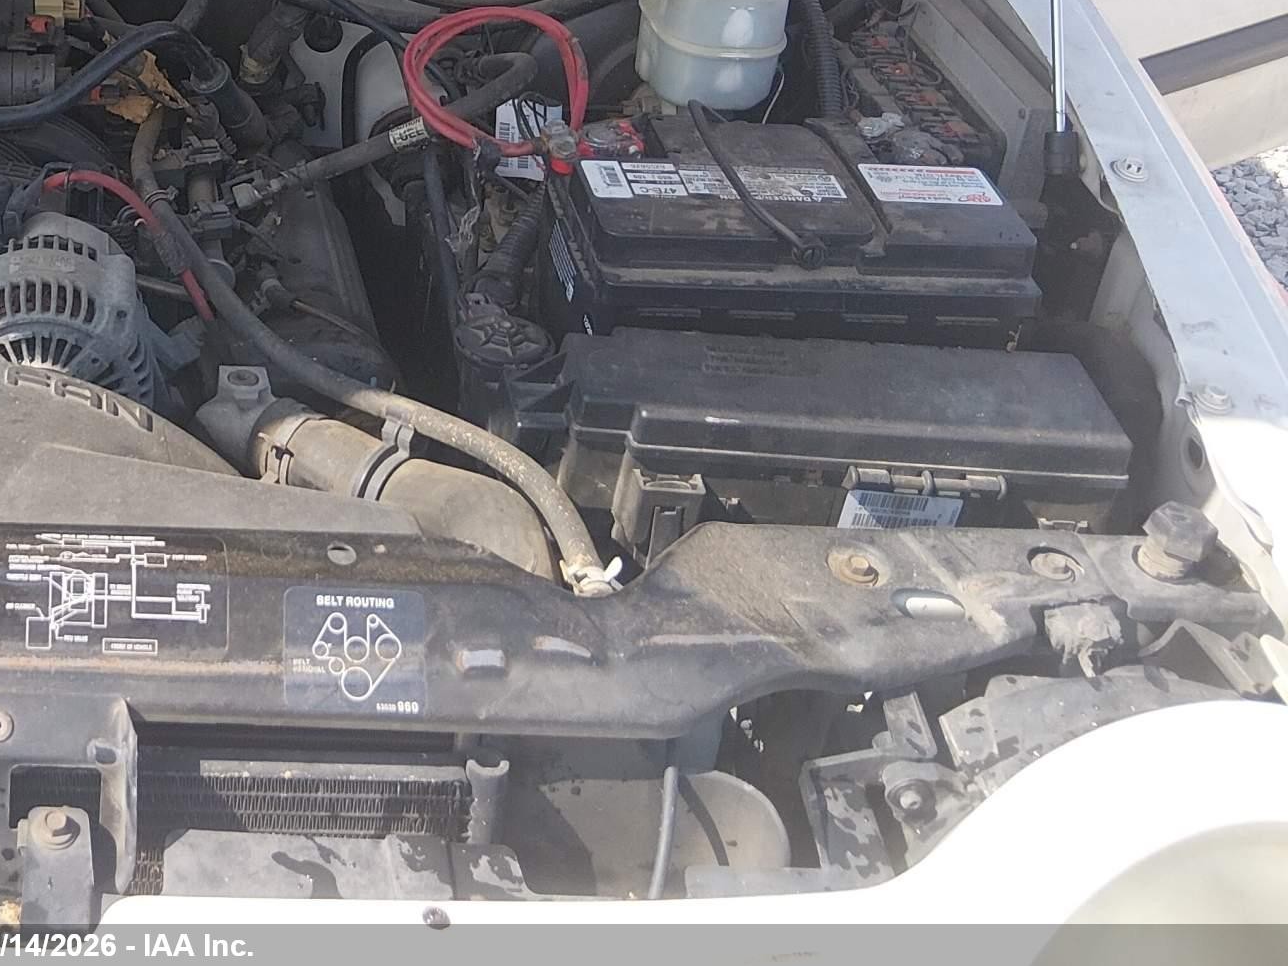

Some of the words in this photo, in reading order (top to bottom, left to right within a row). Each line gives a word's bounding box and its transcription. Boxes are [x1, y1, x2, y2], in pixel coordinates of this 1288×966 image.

[6, 365, 154, 433] FAN
[316, 595, 343, 606] BELT
[345, 596, 394, 609] ROUTING
